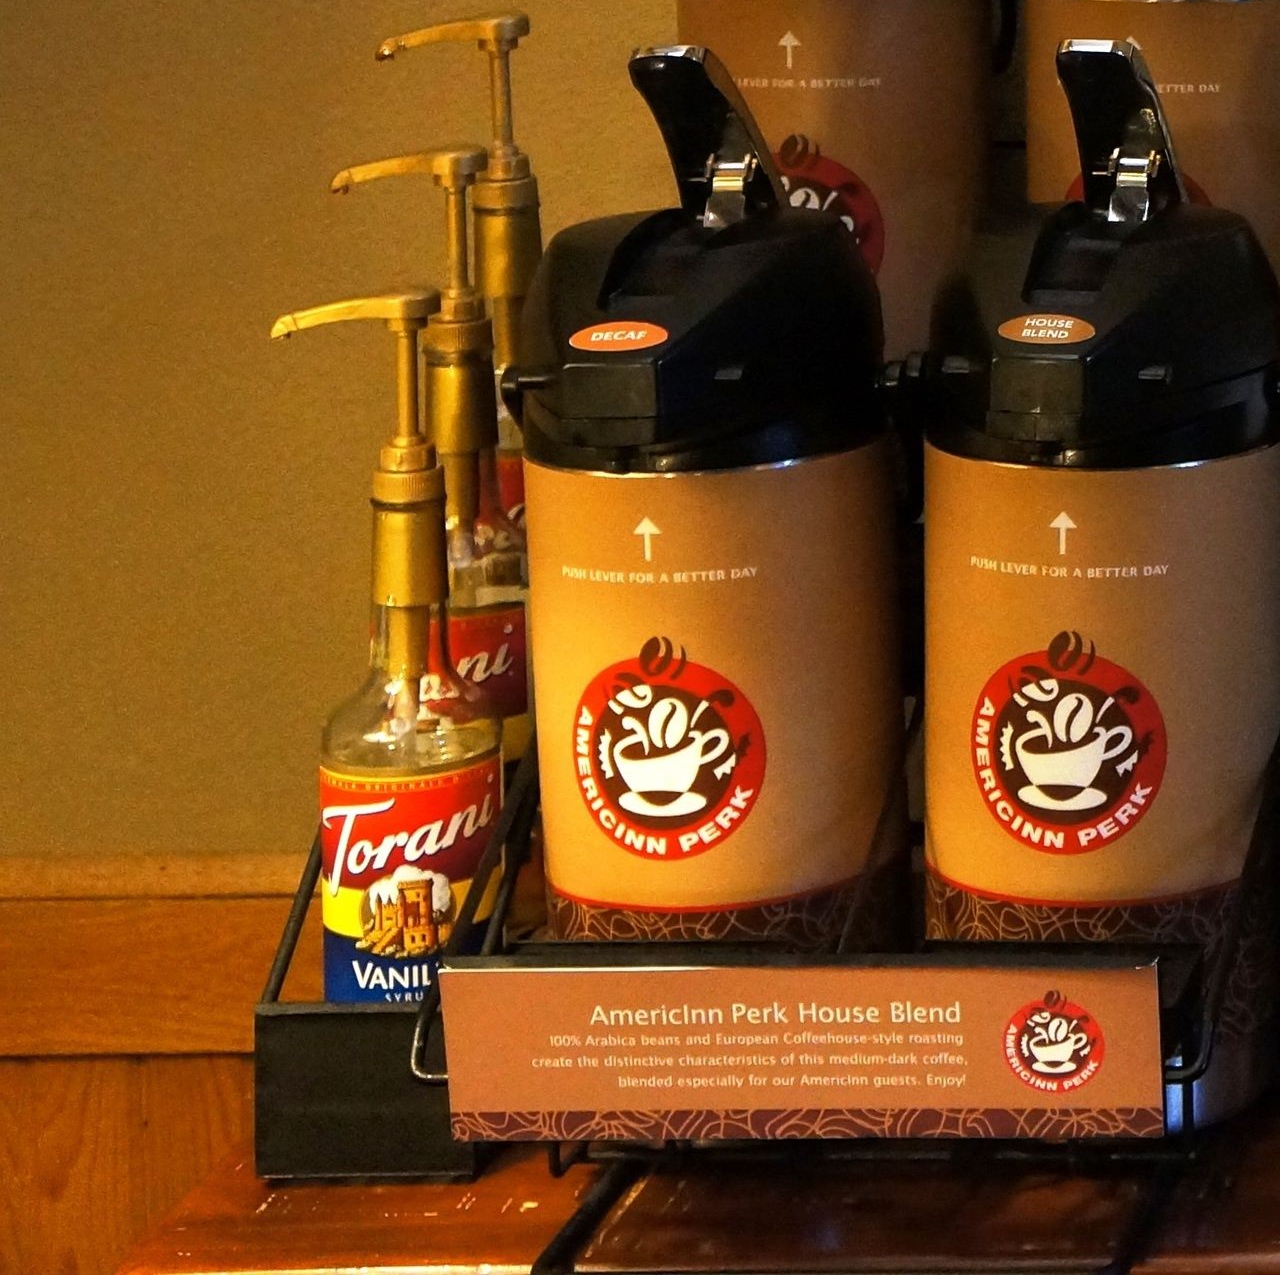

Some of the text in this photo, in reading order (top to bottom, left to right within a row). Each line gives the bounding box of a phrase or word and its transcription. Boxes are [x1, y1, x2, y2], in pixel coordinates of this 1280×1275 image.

[1155, 84, 1221, 94] ETTER DAY
[1024, 318, 1074, 329] HOUSE
[591, 331, 648, 342] DECAF
[1021, 329, 1069, 339] BLEND
[562, 565, 758, 584] PUSH LEVER FOR A BETTER DAY
[970, 556, 1169, 578] PUSH LEVER FOR A BETTER DAY
[575, 705, 754, 855] AMERICINN PERK
[975, 696, 1153, 849] AMERICINN PERK
[322, 773, 495, 898] Torani
[352, 960, 439, 990] VANIL
[385, 990, 424, 1002] SYRU
[590, 1001, 961, 1025] AmericInn Perk House Blend
[549, 1032, 964, 1047] 100% Arabica beans and European Coffeehouse-style roasting
[532, 1053, 968, 1068] create the distinctive characteristics of this medium-dark coffee,
[1006, 1023, 1099, 1091] AMERICINN PERK
[618, 1074, 966, 1088] blended especially for our AmericInn guests. Enjoy!
